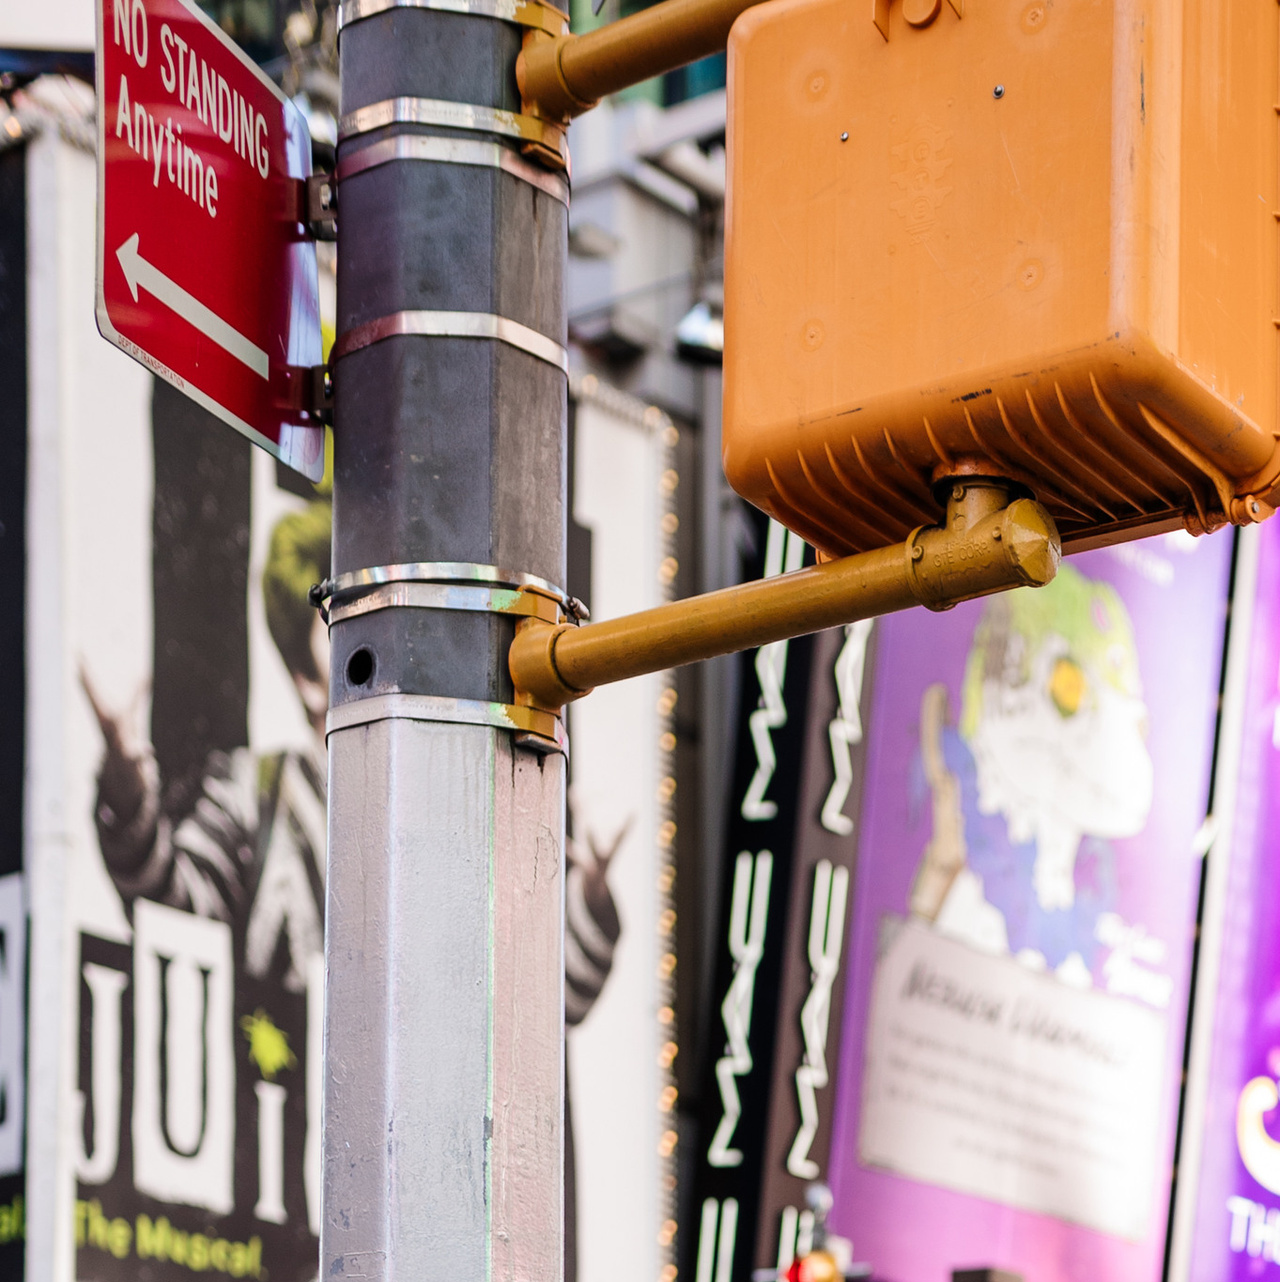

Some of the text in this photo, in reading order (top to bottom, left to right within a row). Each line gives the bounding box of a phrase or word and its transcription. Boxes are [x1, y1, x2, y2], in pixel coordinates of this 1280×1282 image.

[113, 0, 269, 180] NO STANDING
[116, 73, 218, 218] Anytime
[140, 350, 185, 389] TRANSPORTATION
[934, 550, 955, 568] GTE
[75, 1197, 133, 1259] The
